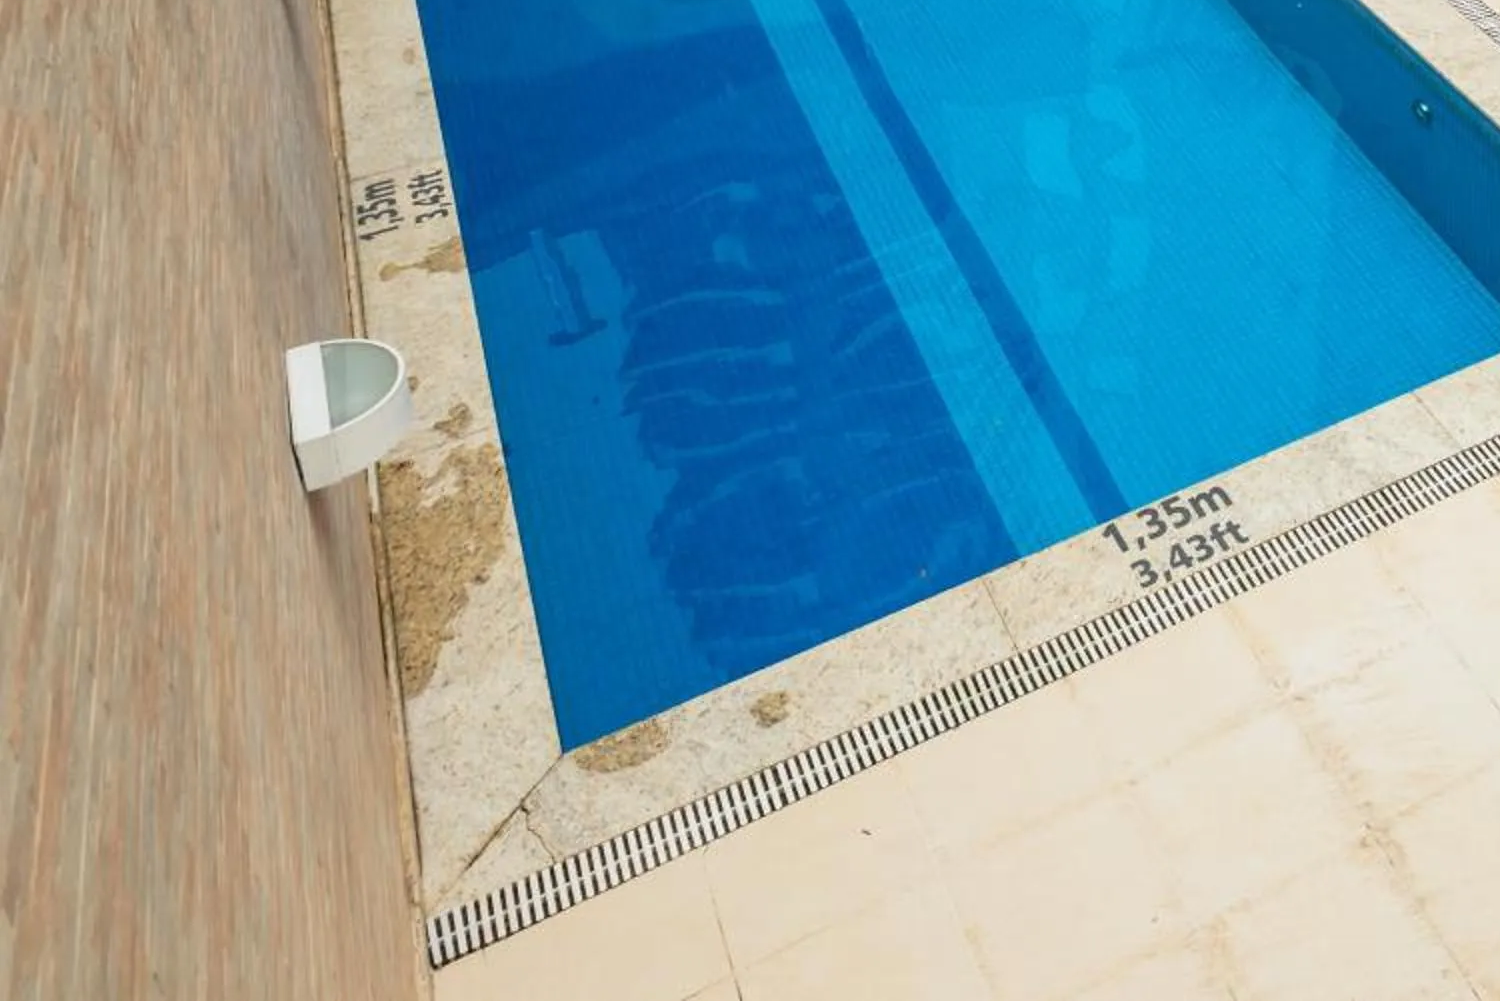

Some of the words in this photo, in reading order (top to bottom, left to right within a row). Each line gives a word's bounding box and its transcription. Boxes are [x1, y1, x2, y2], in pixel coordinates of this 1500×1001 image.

[357, 179, 404, 240] 1,35m
[407, 169, 452, 224] 3,43ft
[1102, 486, 1233, 553] 1,35m
[1130, 520, 1250, 588] 3,43ft
